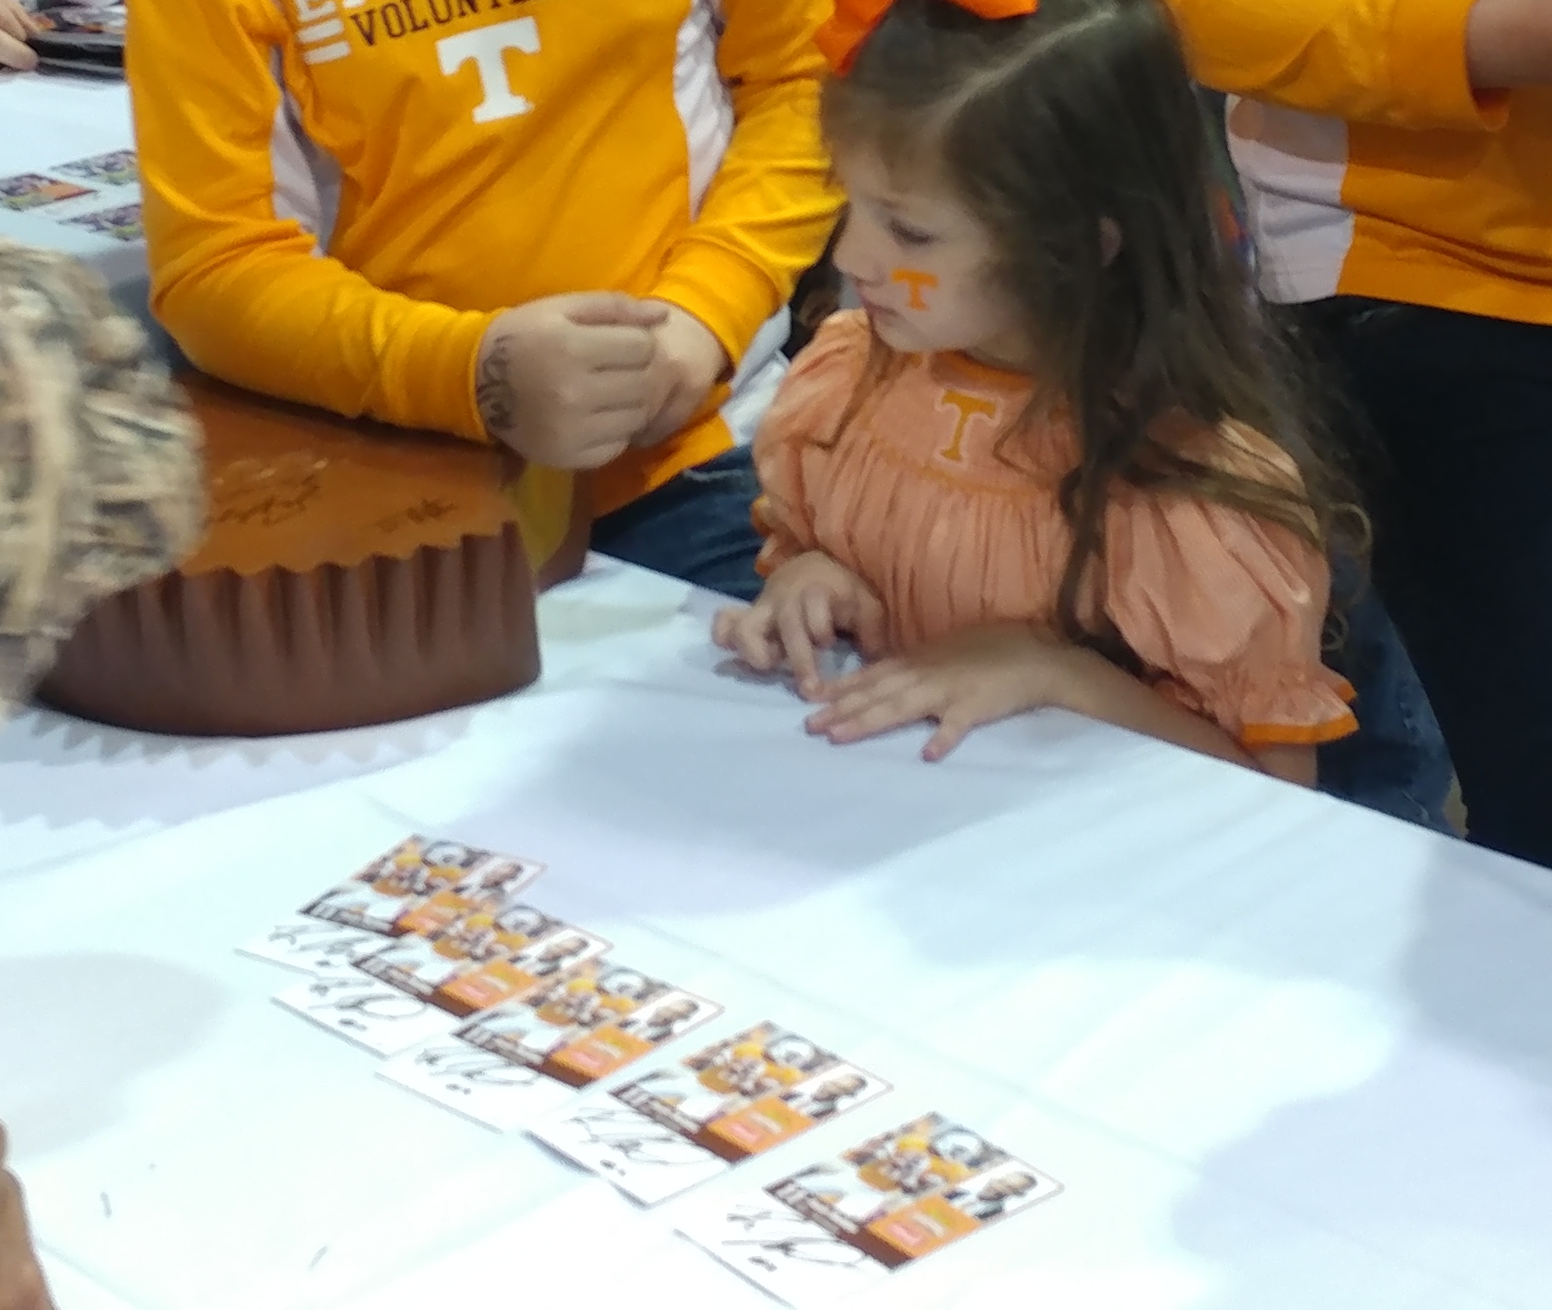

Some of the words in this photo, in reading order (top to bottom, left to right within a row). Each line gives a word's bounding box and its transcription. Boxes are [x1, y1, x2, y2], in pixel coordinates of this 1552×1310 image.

[435, 15, 541, 124] T
[889, 266, 939, 312] T
[936, 386, 1004, 466] T
